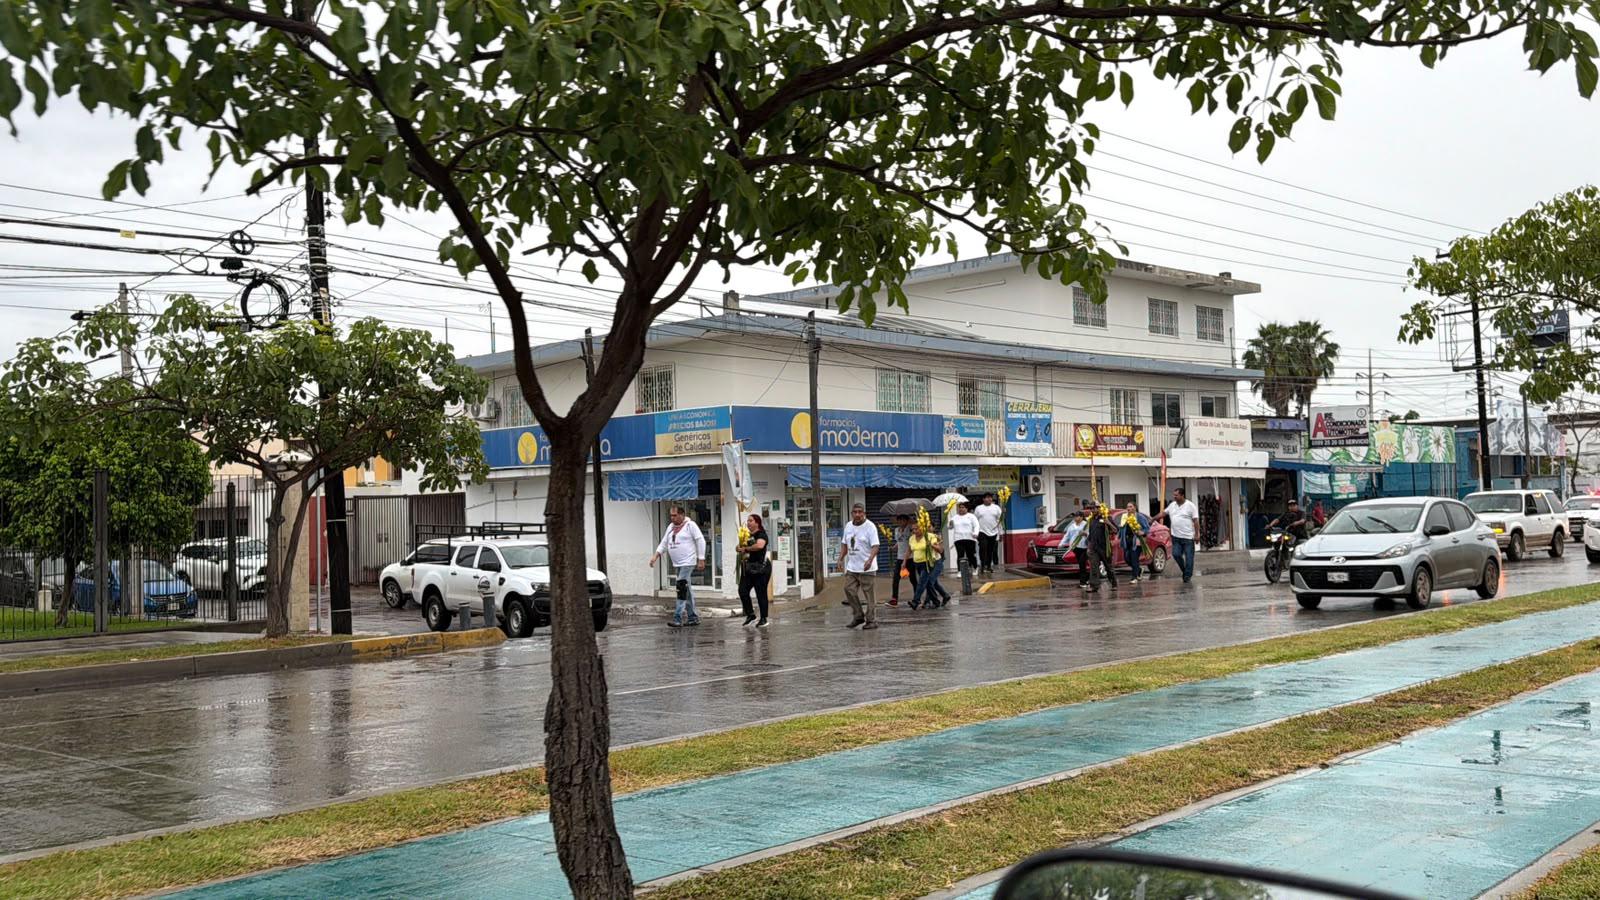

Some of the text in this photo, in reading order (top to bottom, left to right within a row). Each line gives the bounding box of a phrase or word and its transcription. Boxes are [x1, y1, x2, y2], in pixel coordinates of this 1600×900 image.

[1098, 425, 1132, 436] CARNITAS
[674, 432, 711, 441] Genéricos
[820, 426, 899, 448] moderna
[674, 441, 712, 452] de Calidad
[948, 439, 982, 451] 980.00.00
